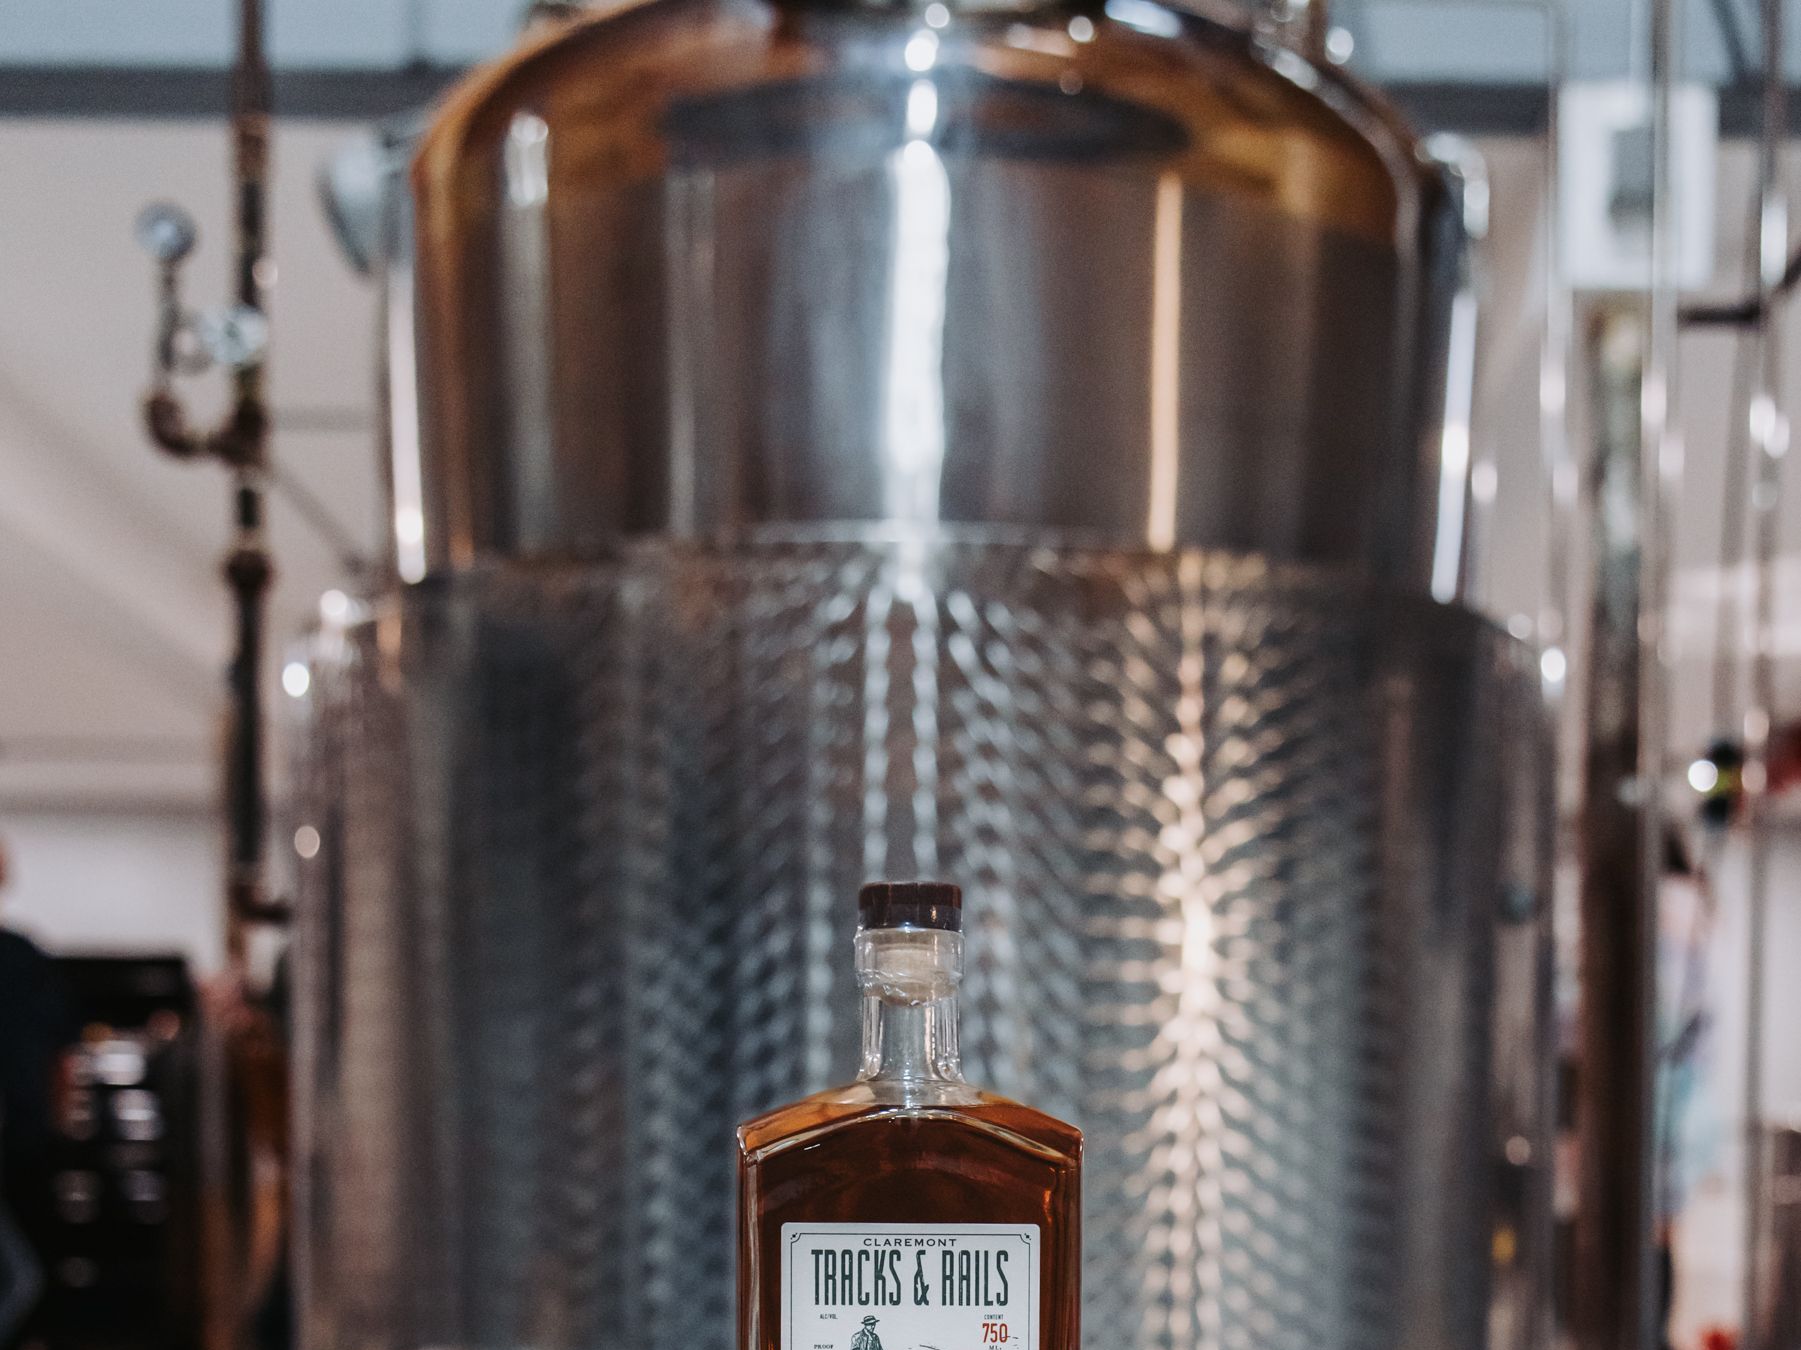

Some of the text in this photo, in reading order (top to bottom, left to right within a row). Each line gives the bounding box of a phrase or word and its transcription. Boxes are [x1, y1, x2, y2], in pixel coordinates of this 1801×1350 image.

[863, 1238, 957, 1247] CLAREMONT
[811, 1249, 1009, 1306] TRACKS & RAILS
[982, 1323, 1008, 1343] 750
